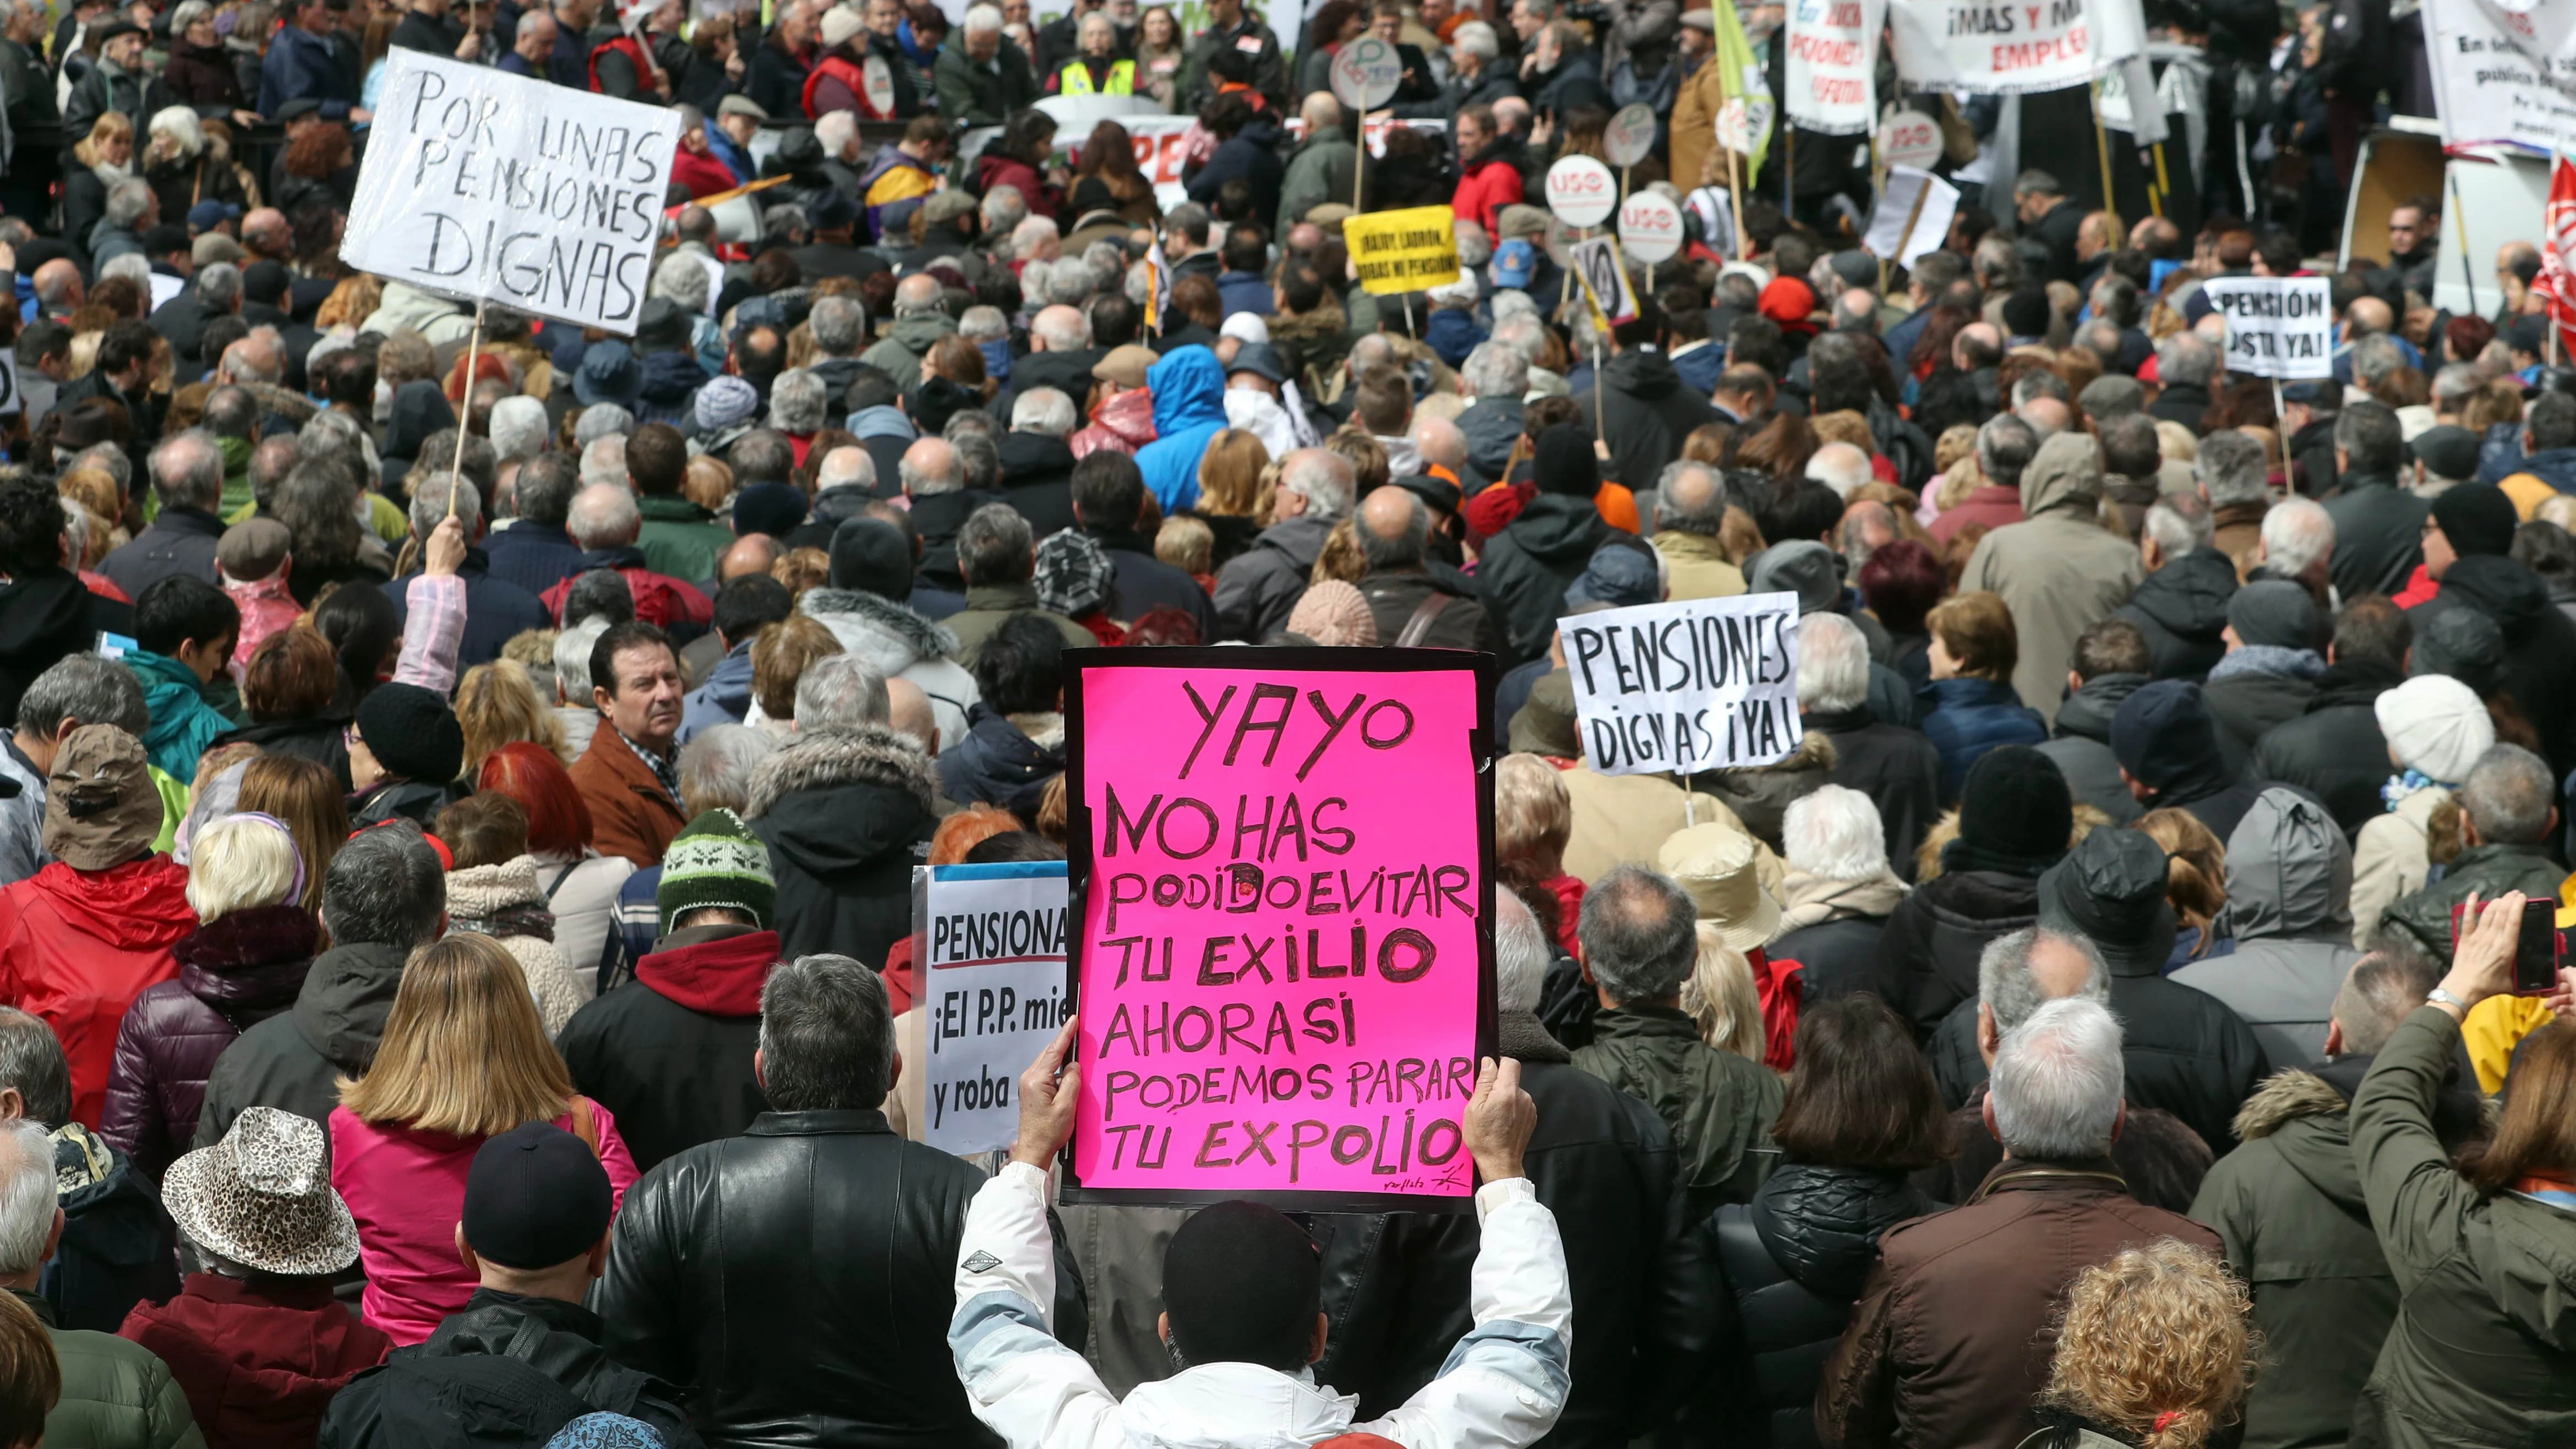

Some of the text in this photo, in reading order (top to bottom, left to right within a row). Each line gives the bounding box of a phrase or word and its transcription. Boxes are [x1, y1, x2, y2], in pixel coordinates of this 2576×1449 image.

[410, 70, 663, 183] POR UNAS
[414, 139, 657, 243] PENSIONES
[410, 212, 647, 321] DIGNAS
[2223, 287, 2322, 318] PENSIÓN
[2285, 332, 2322, 358] YA!
[1573, 609, 1790, 696] PENSIONES
[1182, 680, 1414, 781] YAYO
[1590, 705, 1713, 769] DIGNAS
[1102, 781, 1356, 862] NO HAS
[1099, 935, 1172, 989] TU
[977, 986, 1016, 1036] P.P.
[1099, 1002, 1297, 1058] AHORA
[933, 1064, 1009, 1130] y roba
[1105, 1056, 1473, 1121] PODEMOS PARAR
[1105, 1109, 1461, 1183] TU EXPOLIO
